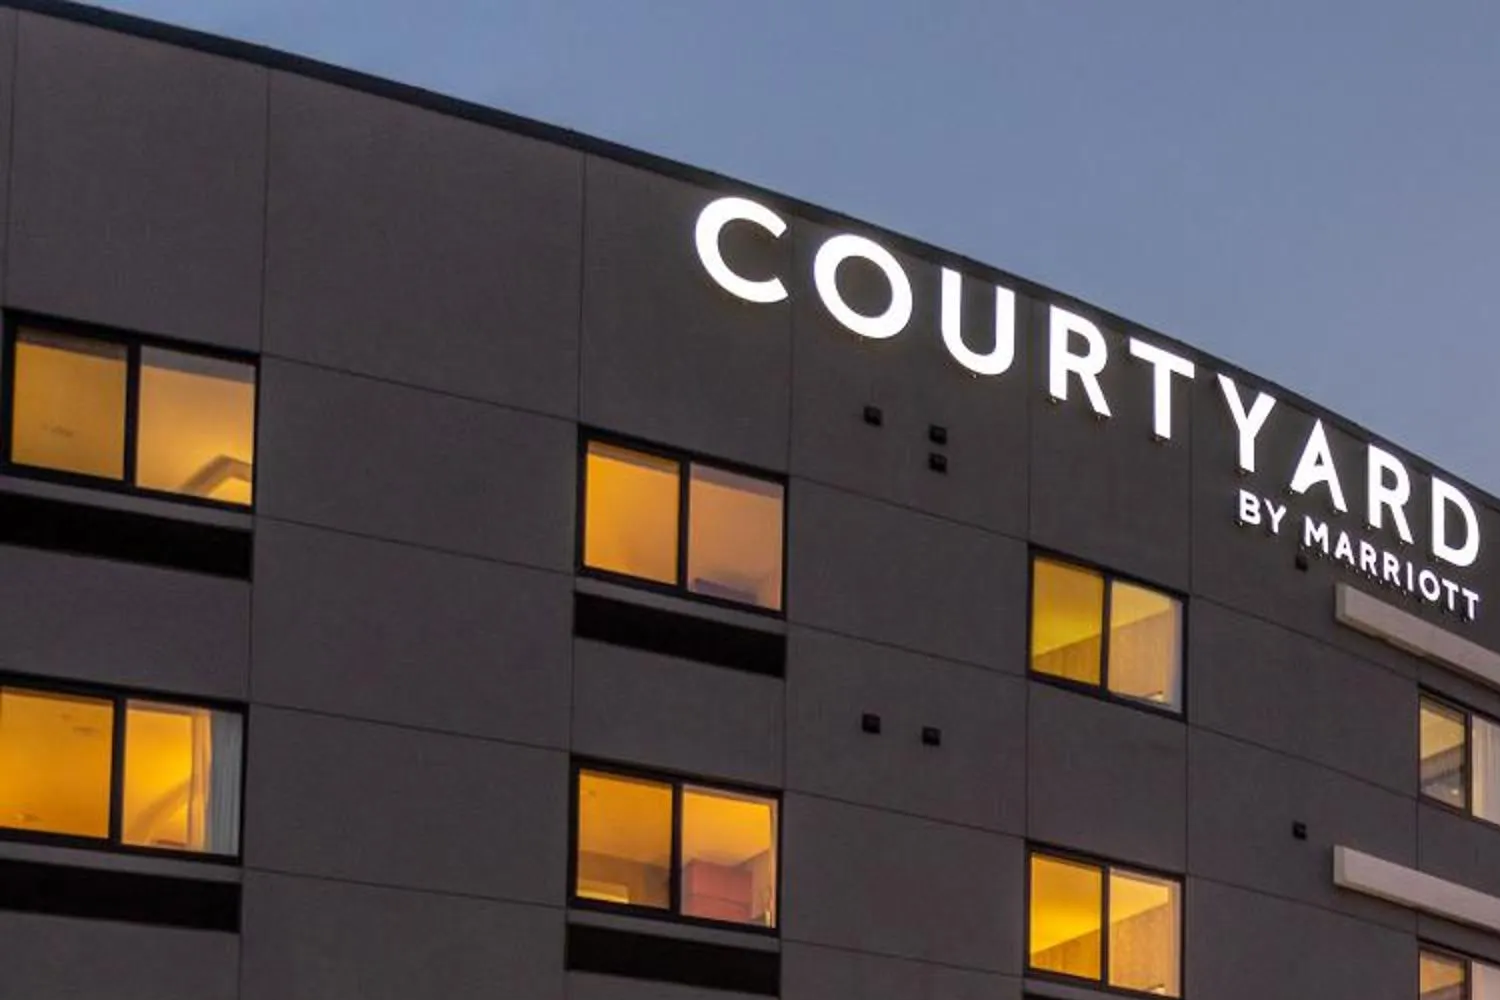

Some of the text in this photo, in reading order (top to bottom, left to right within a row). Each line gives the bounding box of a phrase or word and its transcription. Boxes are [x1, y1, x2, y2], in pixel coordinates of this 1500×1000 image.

[694, 196, 1482, 568] COURTYARD
[1238, 488, 1481, 621] BY MARRIOTT
